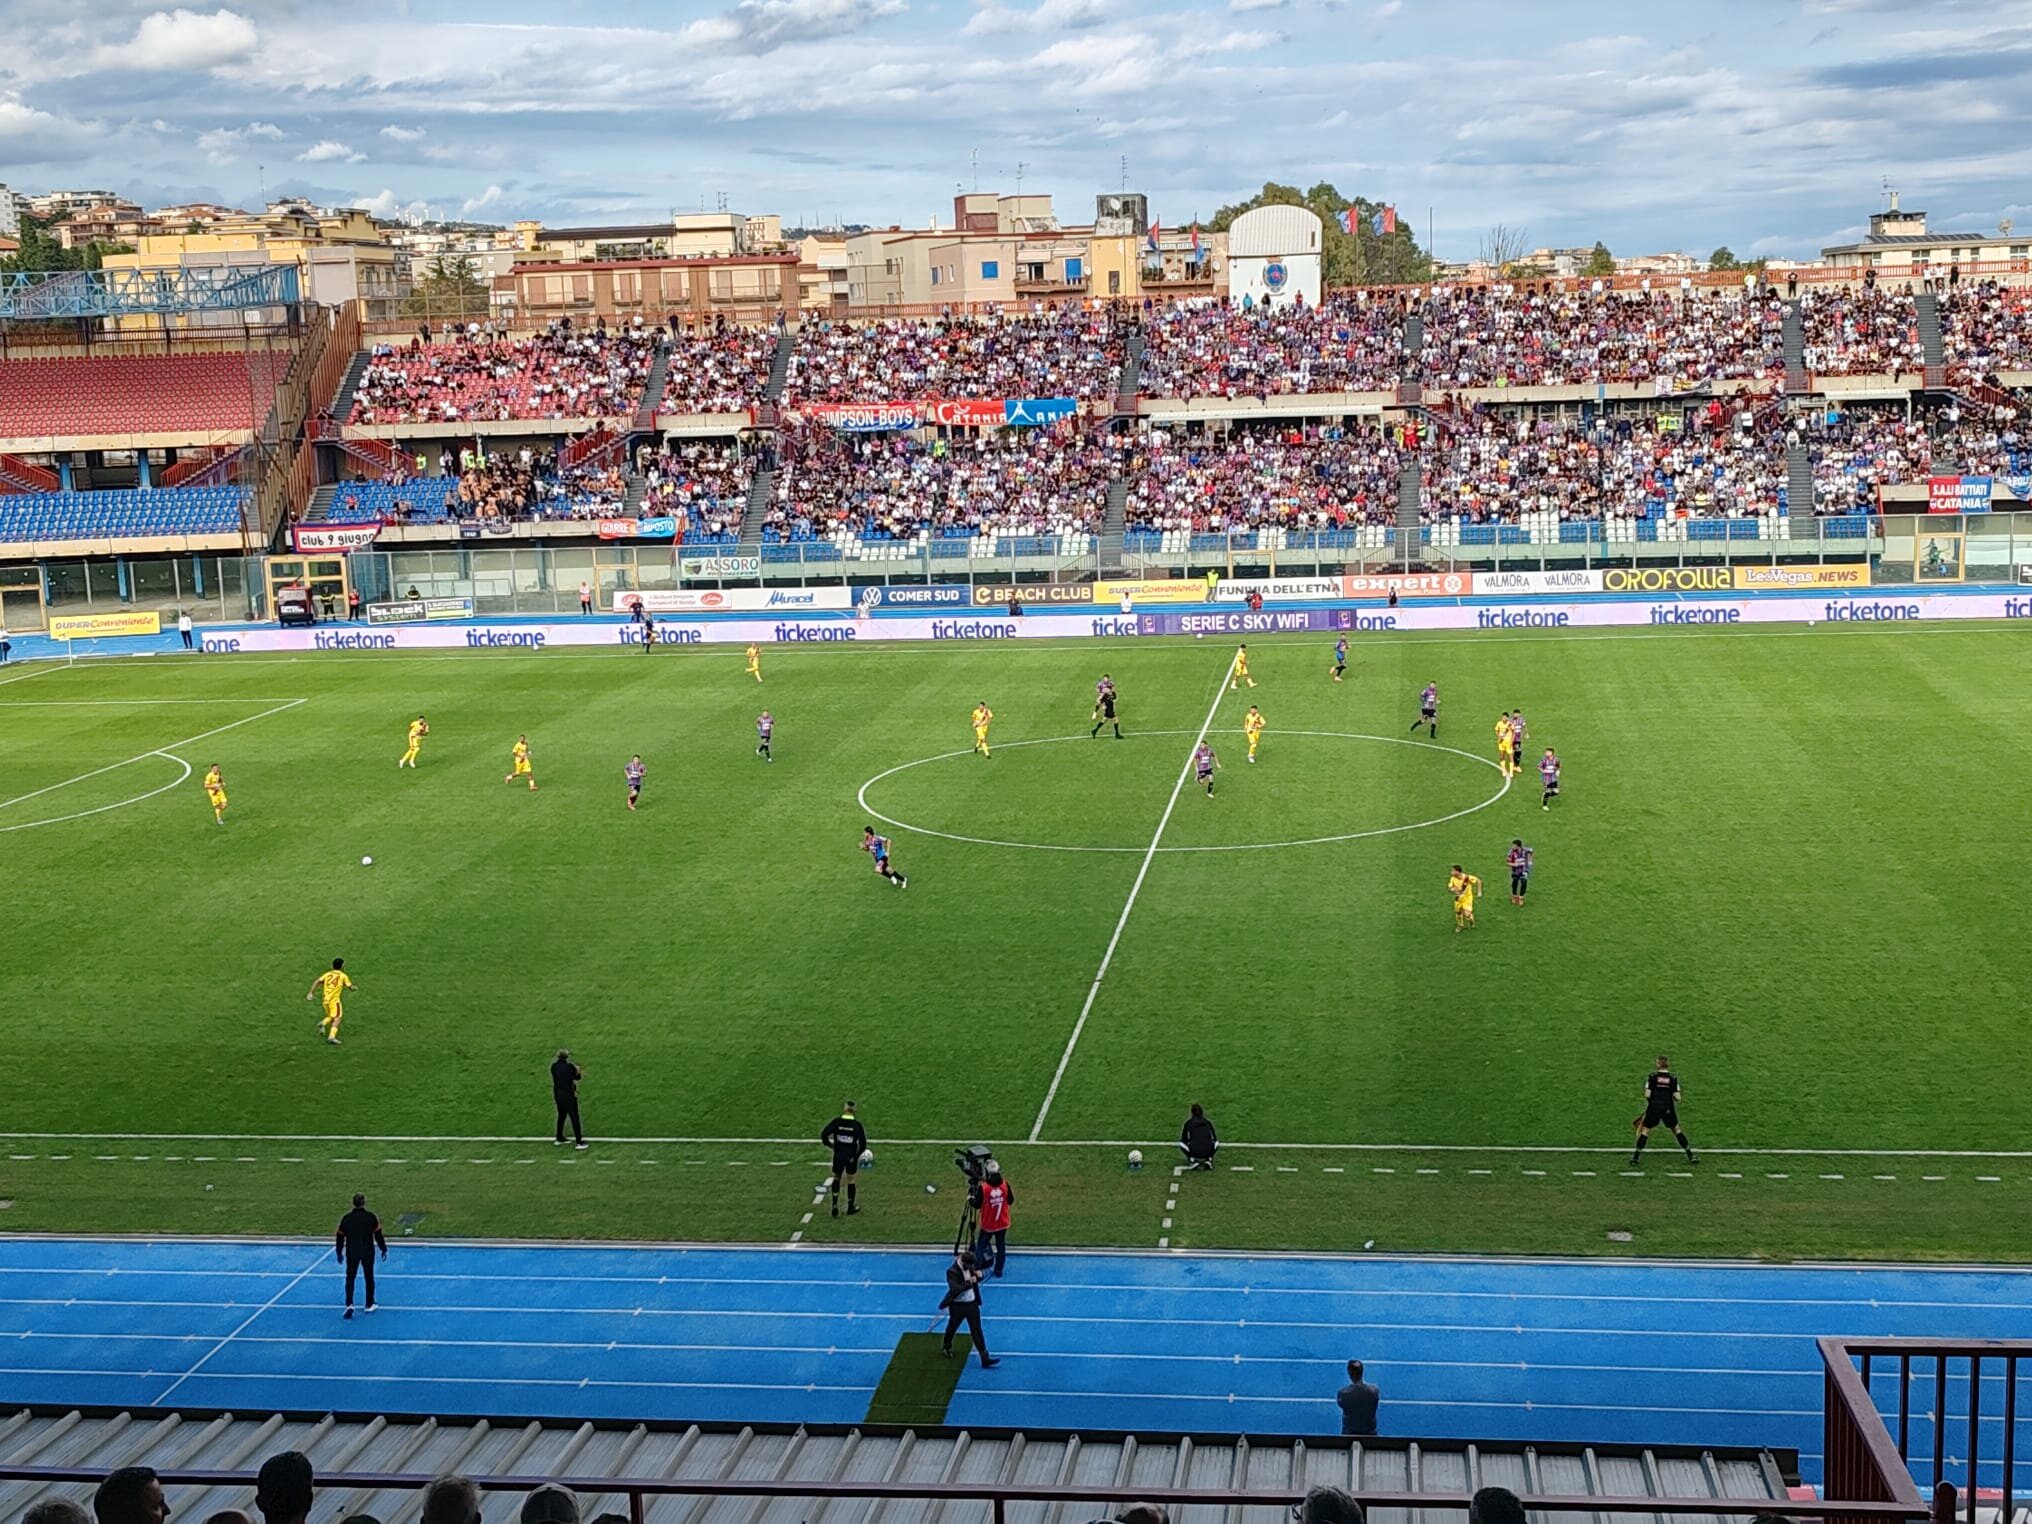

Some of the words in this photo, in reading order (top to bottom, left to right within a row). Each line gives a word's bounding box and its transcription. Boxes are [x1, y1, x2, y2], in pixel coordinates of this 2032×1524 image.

[880, 409, 913, 425] BOYS
[1955, 484, 1988, 496] BATTIATI
[1937, 498, 1981, 509] CATANIA
[601, 522, 629, 533] GIARRE
[301, 535, 324, 546] club
[327, 534, 334, 545] 9
[705, 558, 759, 571] ASSORO
[1352, 574, 1440, 593] expert
[1484, 574, 1530, 588] VALMORA
[1544, 572, 1591, 586] VALMORA
[888, 591, 932, 602] COMER
[934, 590, 959, 601] SUD
[994, 588, 1046, 601] BEACH
[1050, 587, 1091, 600] CLUB
[1478, 608, 1569, 628] ticketone
[1650, 605, 1741, 624] ticketone
[1825, 601, 1920, 621] ticketone
[931, 620, 1017, 639] ticketone
[1091, 618, 1138, 636] ticke
[1181, 615, 1226, 631] SERIE
[1228, 614, 1240, 630] C
[1243, 614, 1274, 629] SKY
[1277, 613, 1309, 629] WIFI
[1356, 615, 1396, 631] one
[314, 631, 395, 649] ticketone
[465, 628, 545, 647] ticketone
[774, 623, 856, 641] ticketone
[201, 638, 240, 652] one
[327, 974, 340, 988] 24
